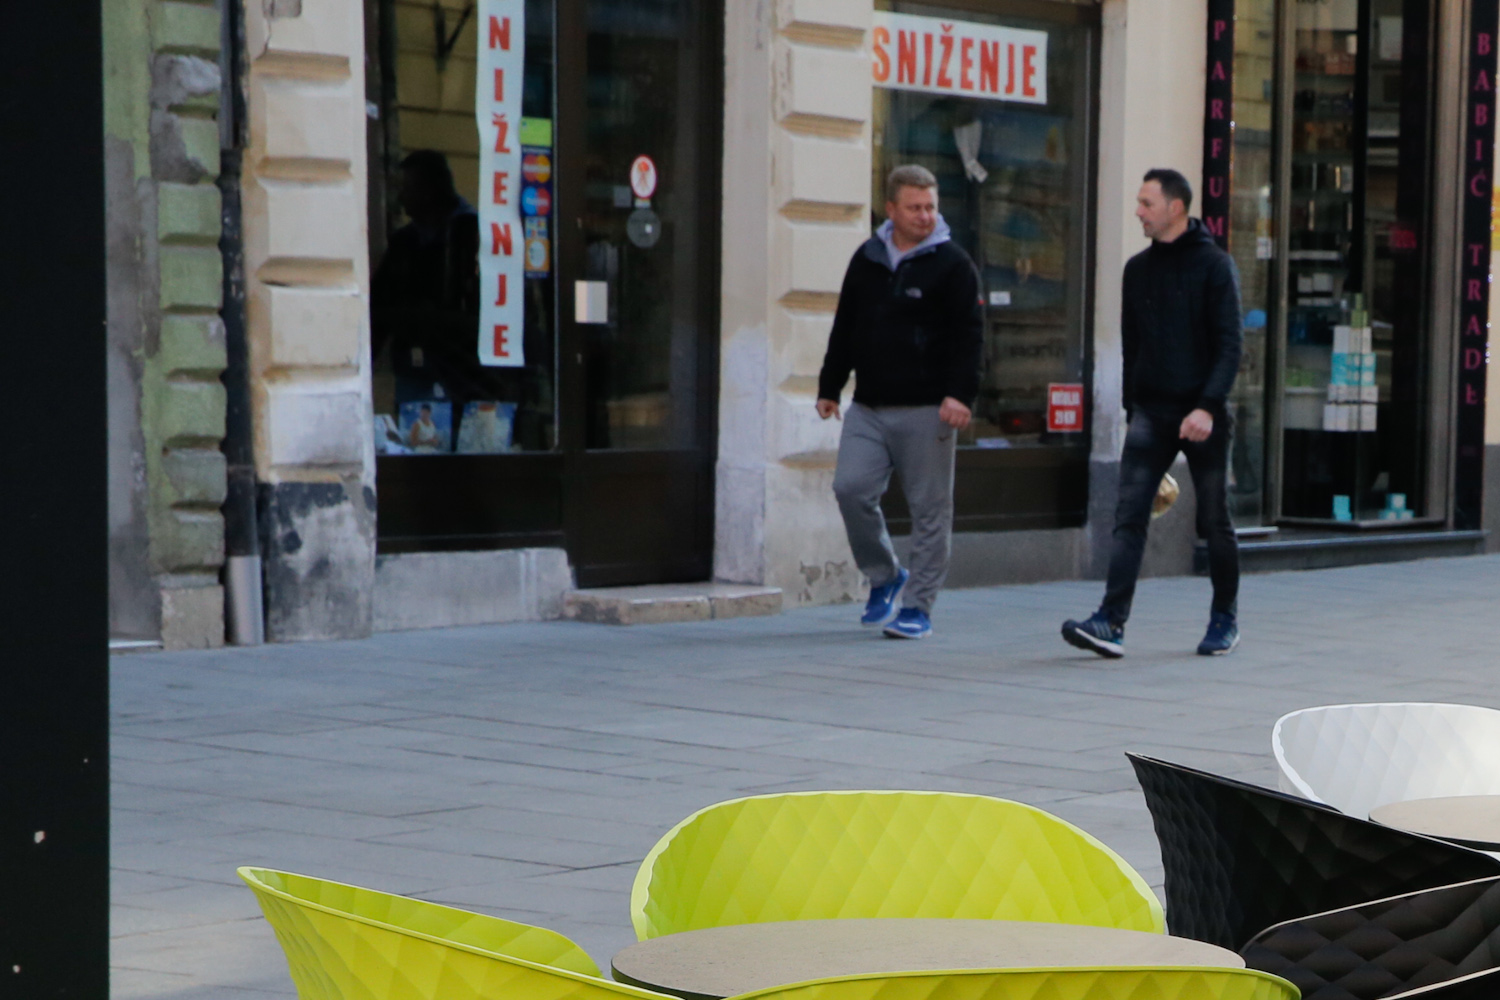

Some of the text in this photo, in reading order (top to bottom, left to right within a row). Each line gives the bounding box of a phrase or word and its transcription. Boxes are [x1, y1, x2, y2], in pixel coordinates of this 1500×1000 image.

[872, 23, 1037, 98] SNIŽENJE
[1206, 20, 1226, 237] PARFUM
[1470, 32, 1491, 197] BABIĆ
